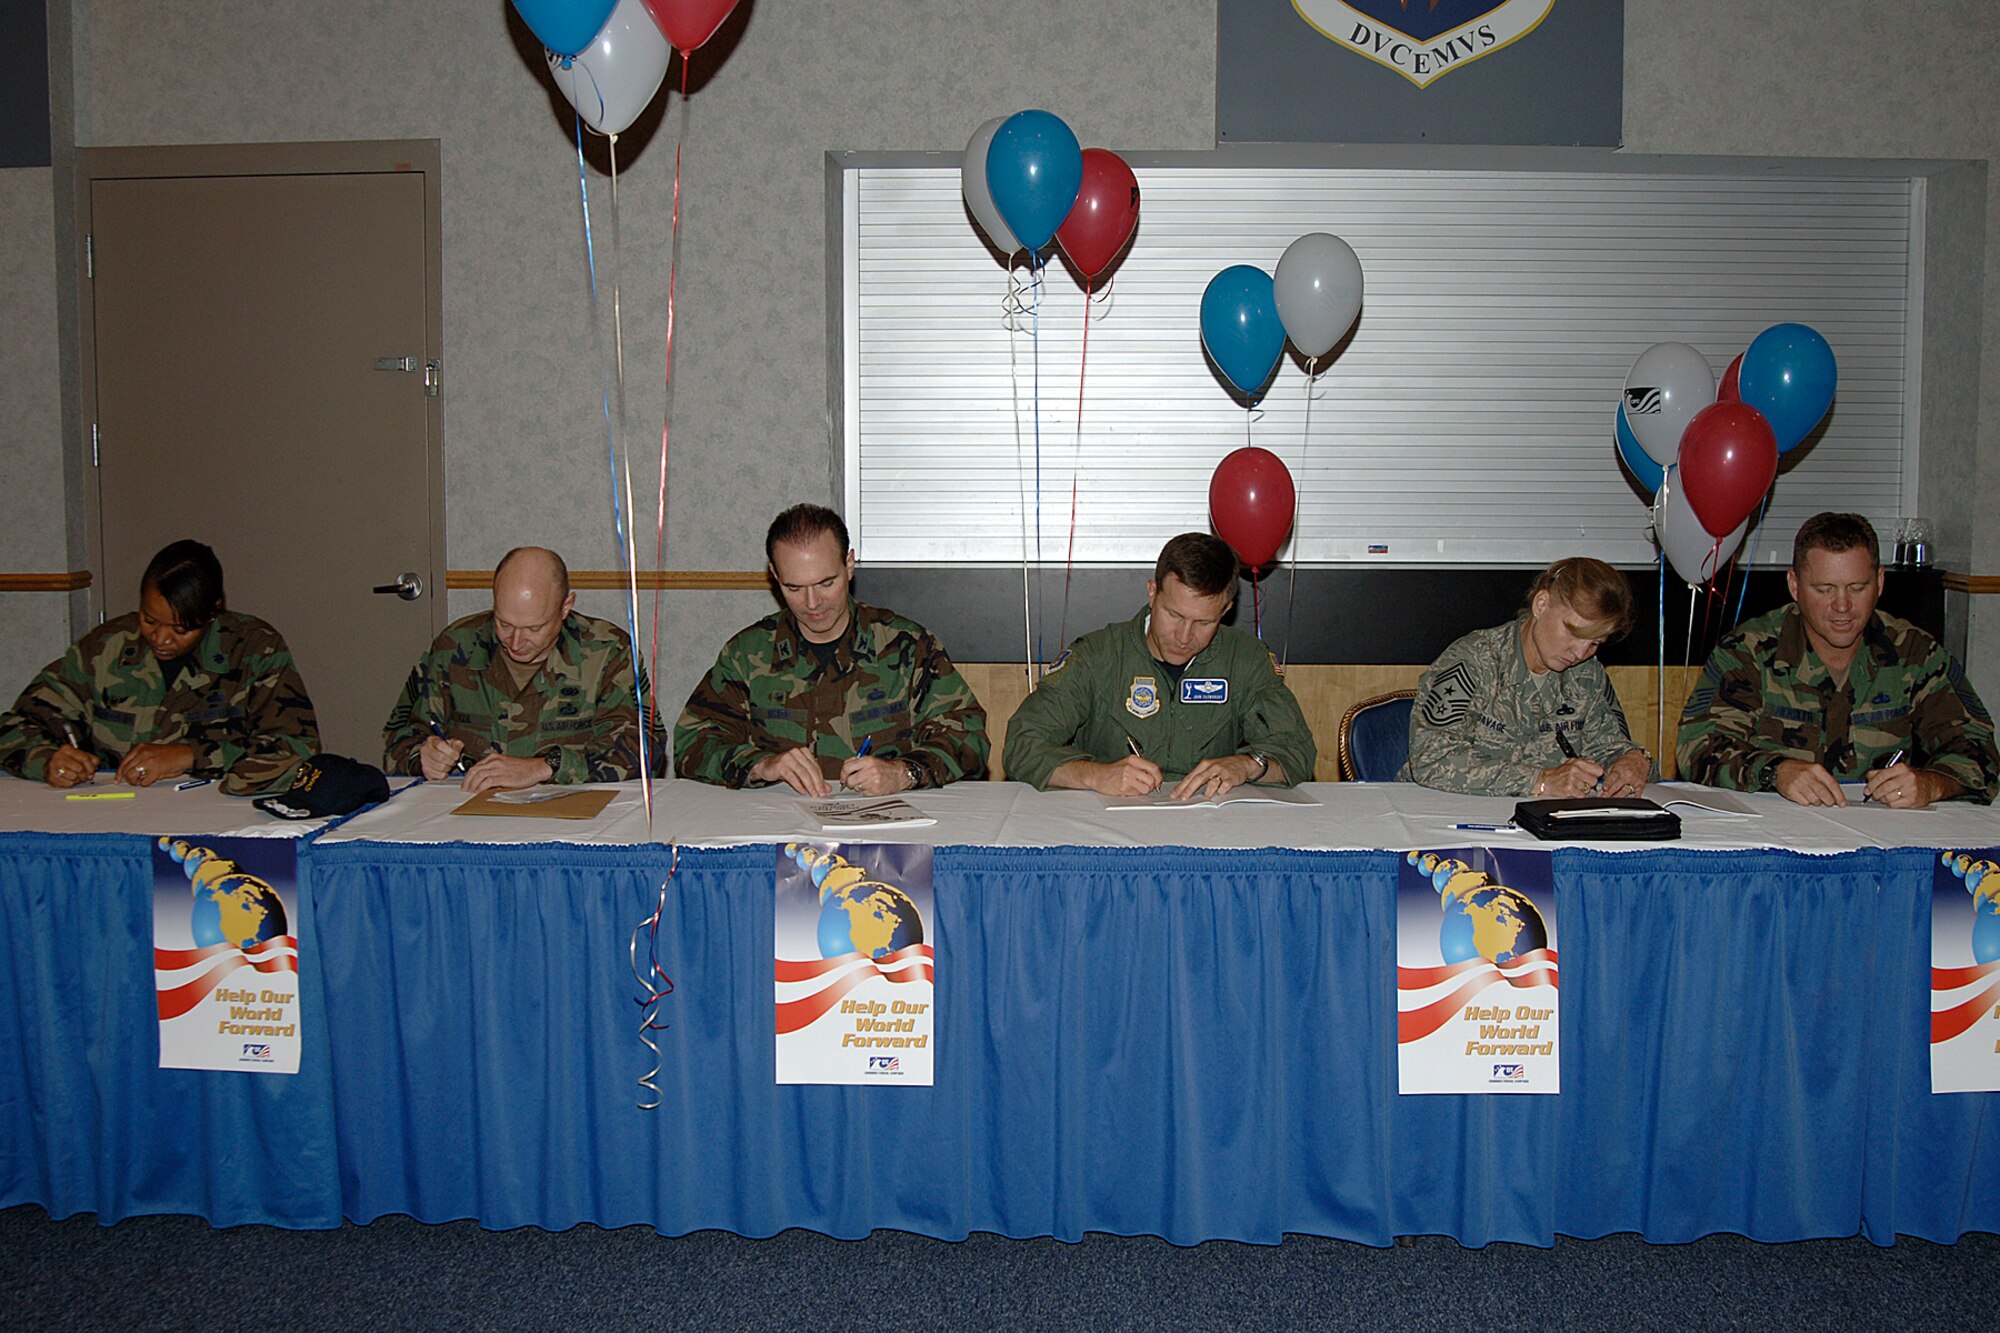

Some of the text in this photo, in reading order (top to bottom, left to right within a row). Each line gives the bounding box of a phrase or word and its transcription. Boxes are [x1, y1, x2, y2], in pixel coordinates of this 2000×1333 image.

[1348, 21, 1496, 74] DVCEMVS
[214, 988, 295, 1005] Help Our
[229, 1006, 283, 1021] World
[840, 1000, 929, 1017] Help Our
[1464, 1006, 1554, 1023] Help Our
[218, 1021, 295, 1037] Forward
[856, 1018, 915, 1032] World
[1479, 1024, 1540, 1039] World
[842, 1034, 928, 1048] Forward
[1465, 1041, 1553, 1056] Forward
